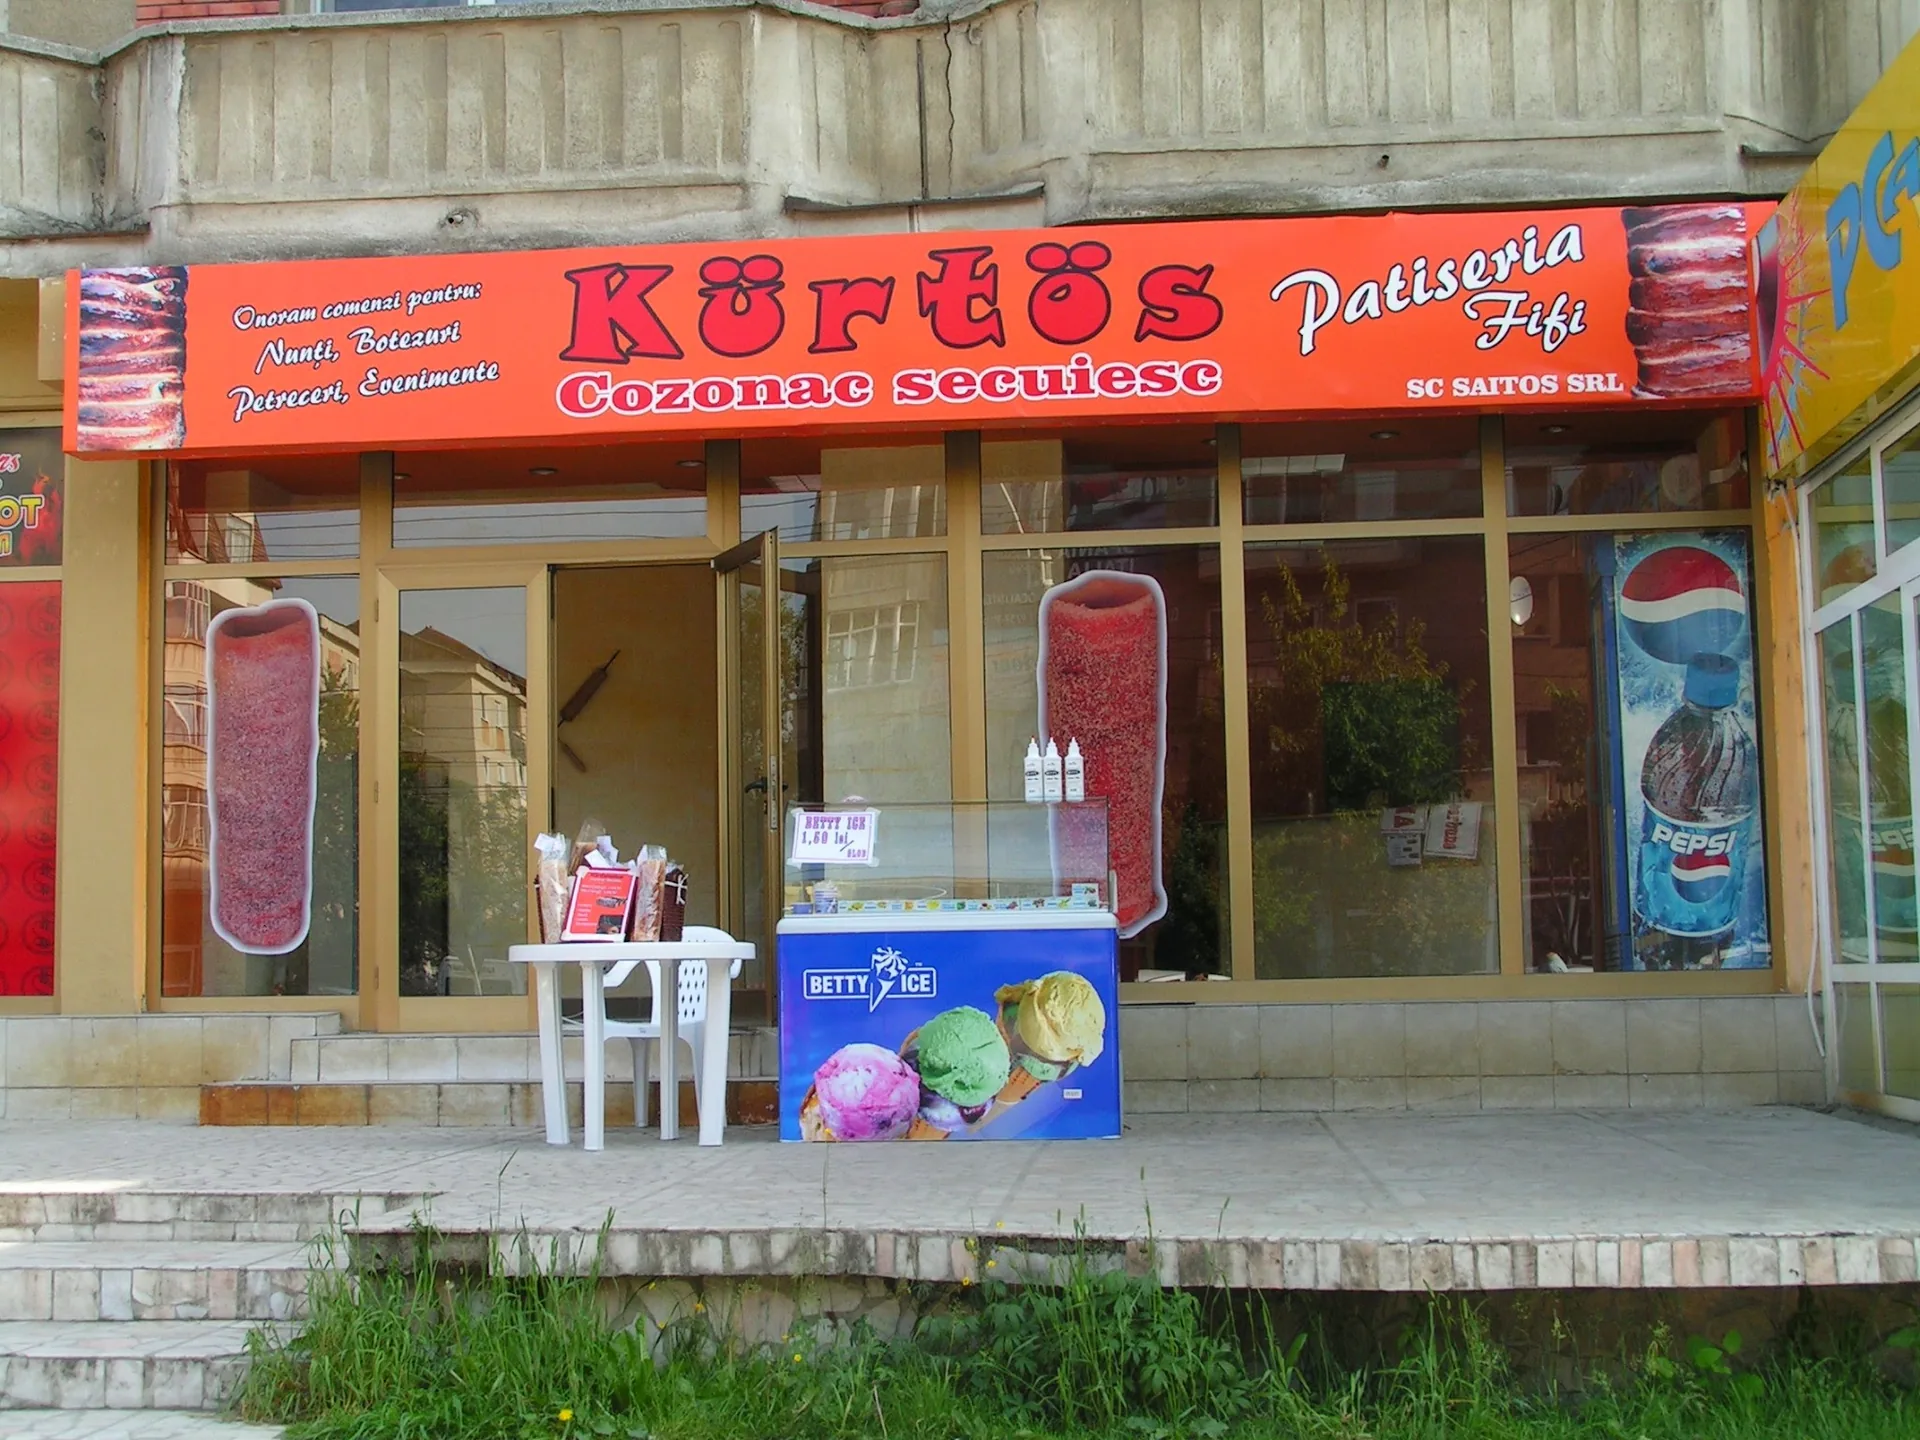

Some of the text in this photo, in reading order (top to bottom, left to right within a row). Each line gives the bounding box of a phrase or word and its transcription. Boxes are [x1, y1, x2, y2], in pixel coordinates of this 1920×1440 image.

[233, 282, 482, 331] Onoram comenzi pentru:
[559, 241, 1223, 364] Kürtös
[1271, 223, 1584, 356] Patiseria
[348, 320, 461, 355] Botezuri
[1463, 290, 1587, 353] Fifi
[228, 361, 500, 422] Petreceri, Evenimente
[556, 352, 1223, 418] Cozonac secuiesc
[1407, 373, 1624, 399] SC SAITOS SRL
[805, 816, 866, 830] BETTY ICE
[1651, 823, 1737, 856] PEPSI
[810, 973, 931, 994] BETTY ICE
